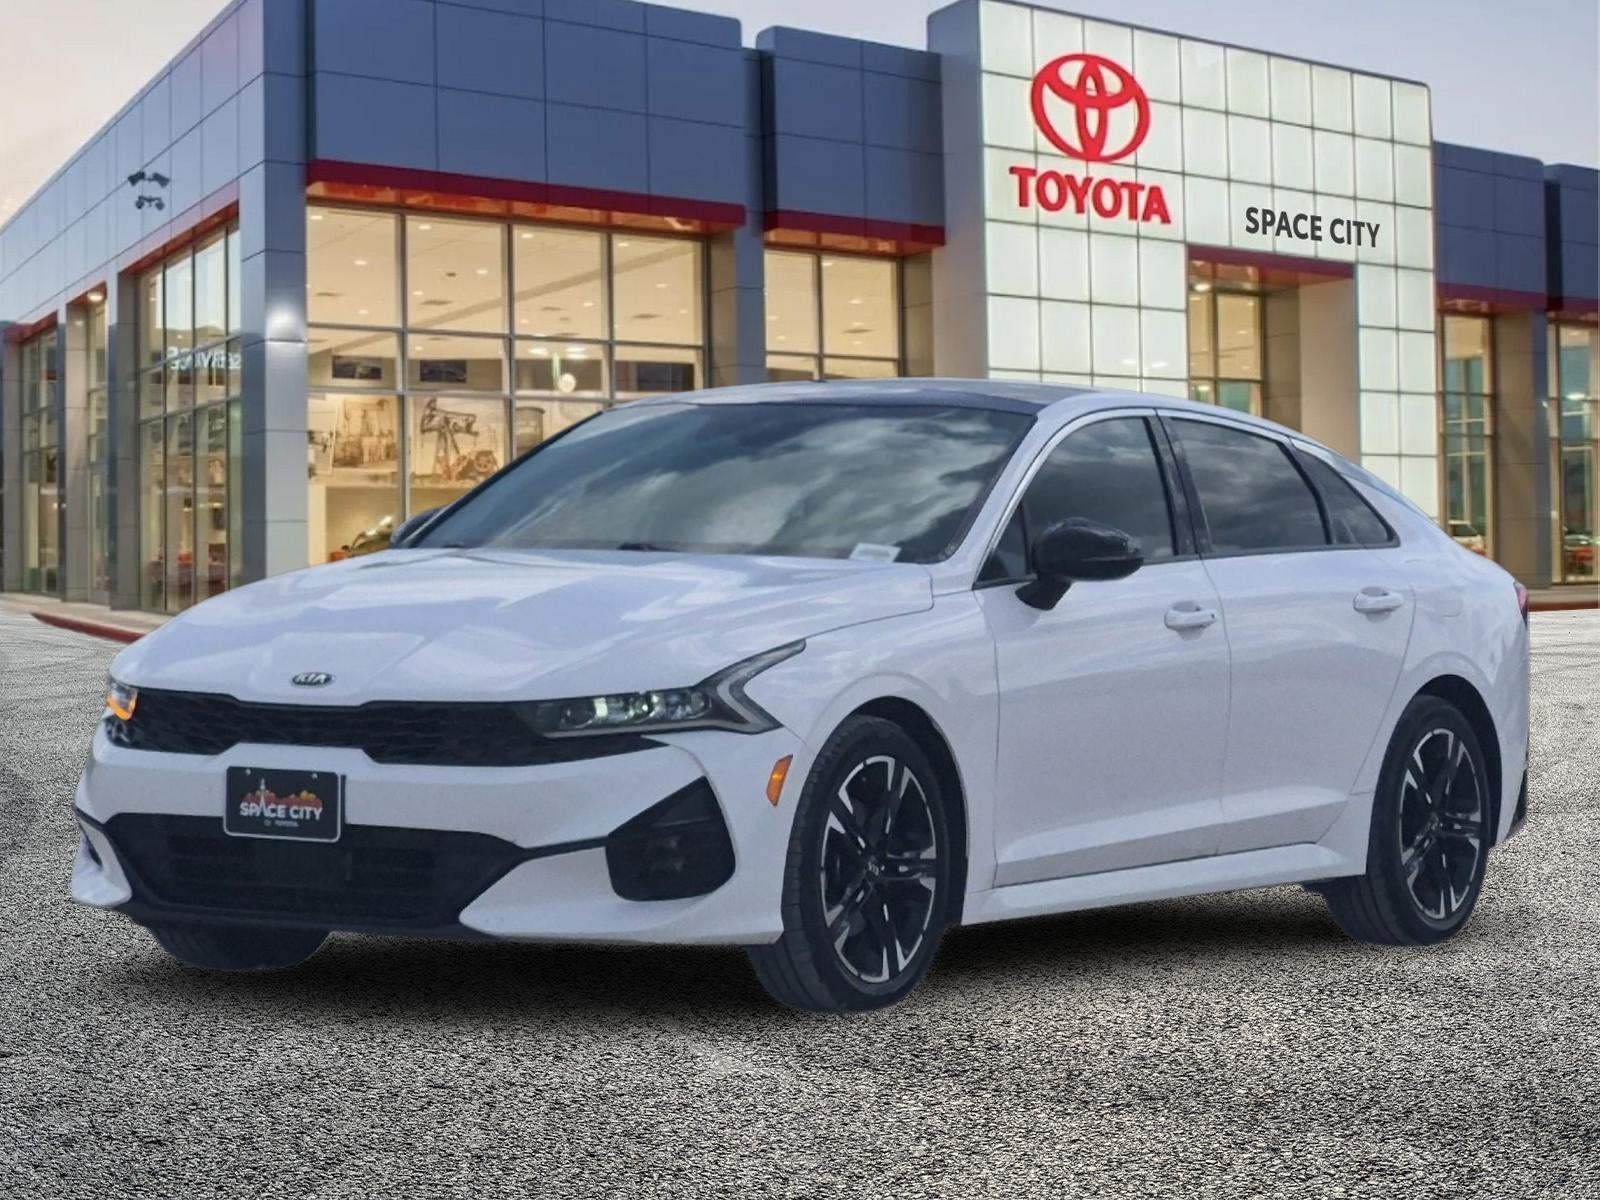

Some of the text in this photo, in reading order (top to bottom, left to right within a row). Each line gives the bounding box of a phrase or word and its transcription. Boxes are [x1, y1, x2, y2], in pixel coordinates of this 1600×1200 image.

[1009, 166, 1171, 225] TOYOTA
[1245, 206, 1381, 248] SPACE CITY
[296, 673, 327, 684] KIA
[240, 802, 323, 820] SPACE CITY
